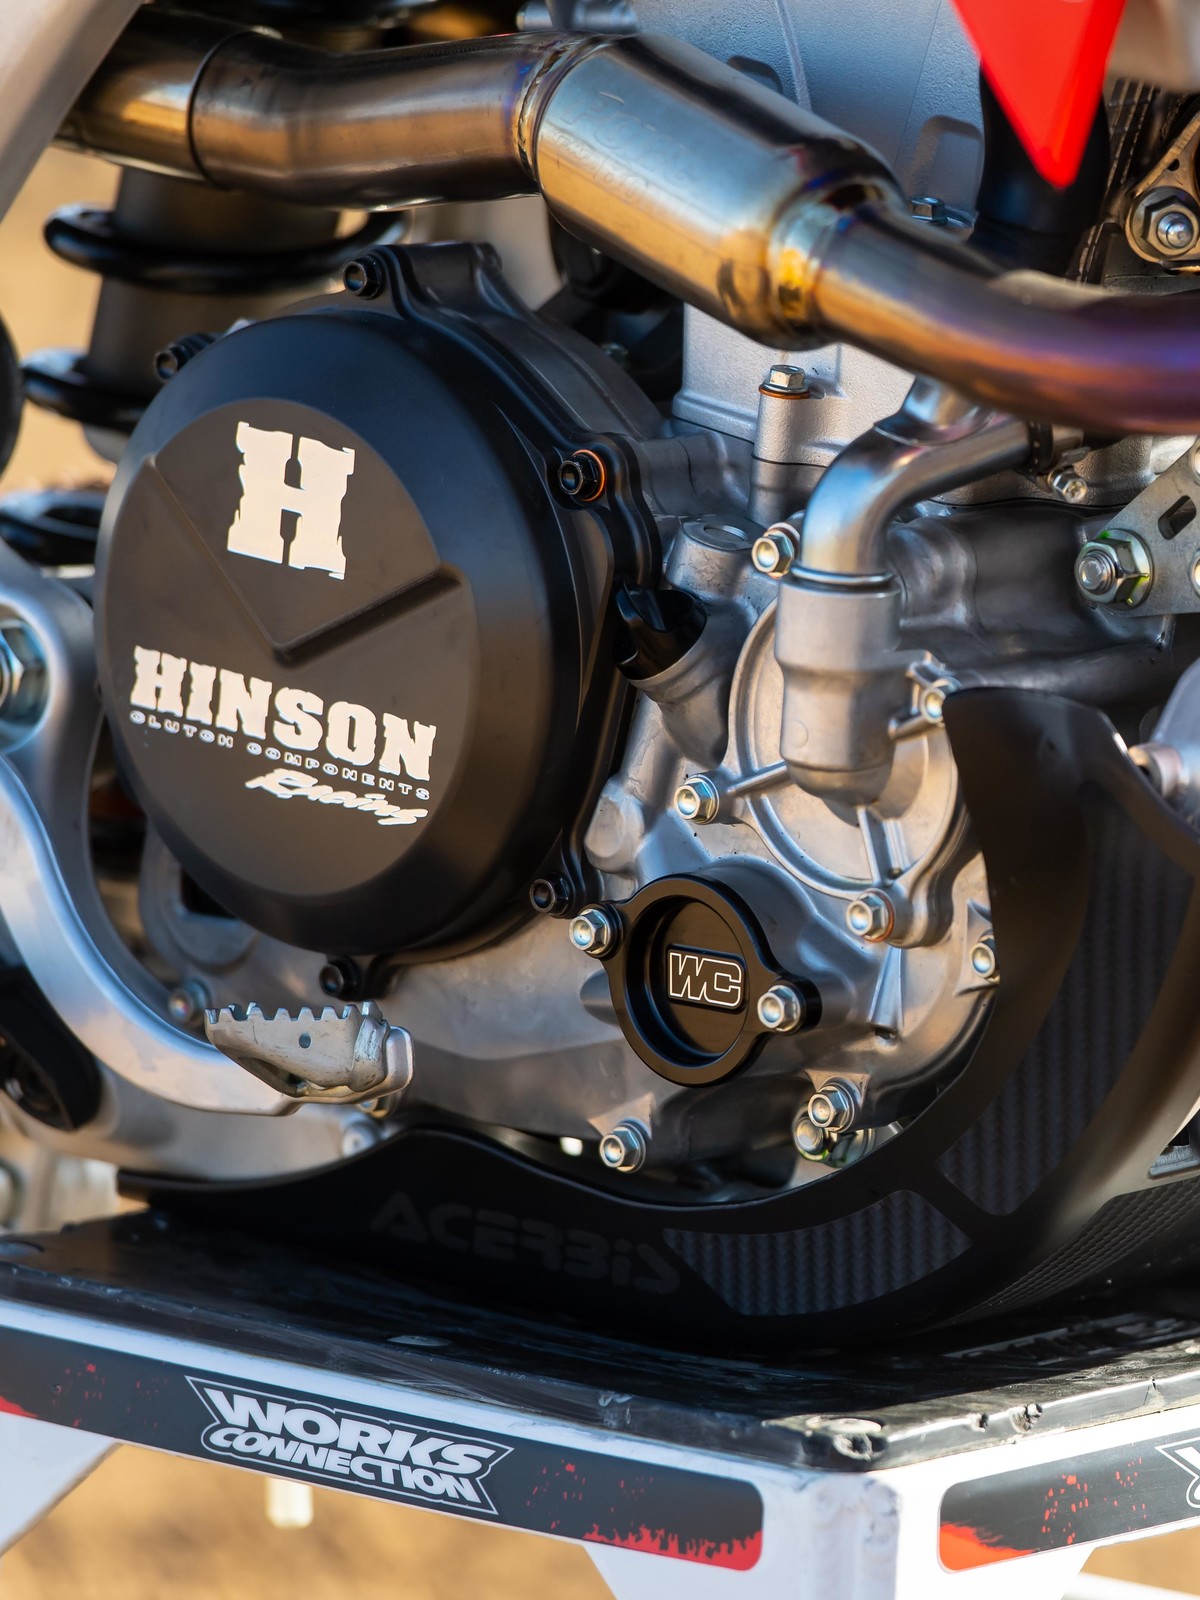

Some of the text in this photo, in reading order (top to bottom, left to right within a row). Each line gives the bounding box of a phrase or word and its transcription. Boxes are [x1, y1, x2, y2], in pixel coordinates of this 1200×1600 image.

[227, 421, 355, 580] H
[129, 710, 430, 800] CLUTCH COMPONENTS
[130, 645, 437, 781] HINSON
[669, 952, 742, 1007] WC
[203, 1387, 496, 1474] WORKS
[208, 1427, 482, 1504] CONNECTION
